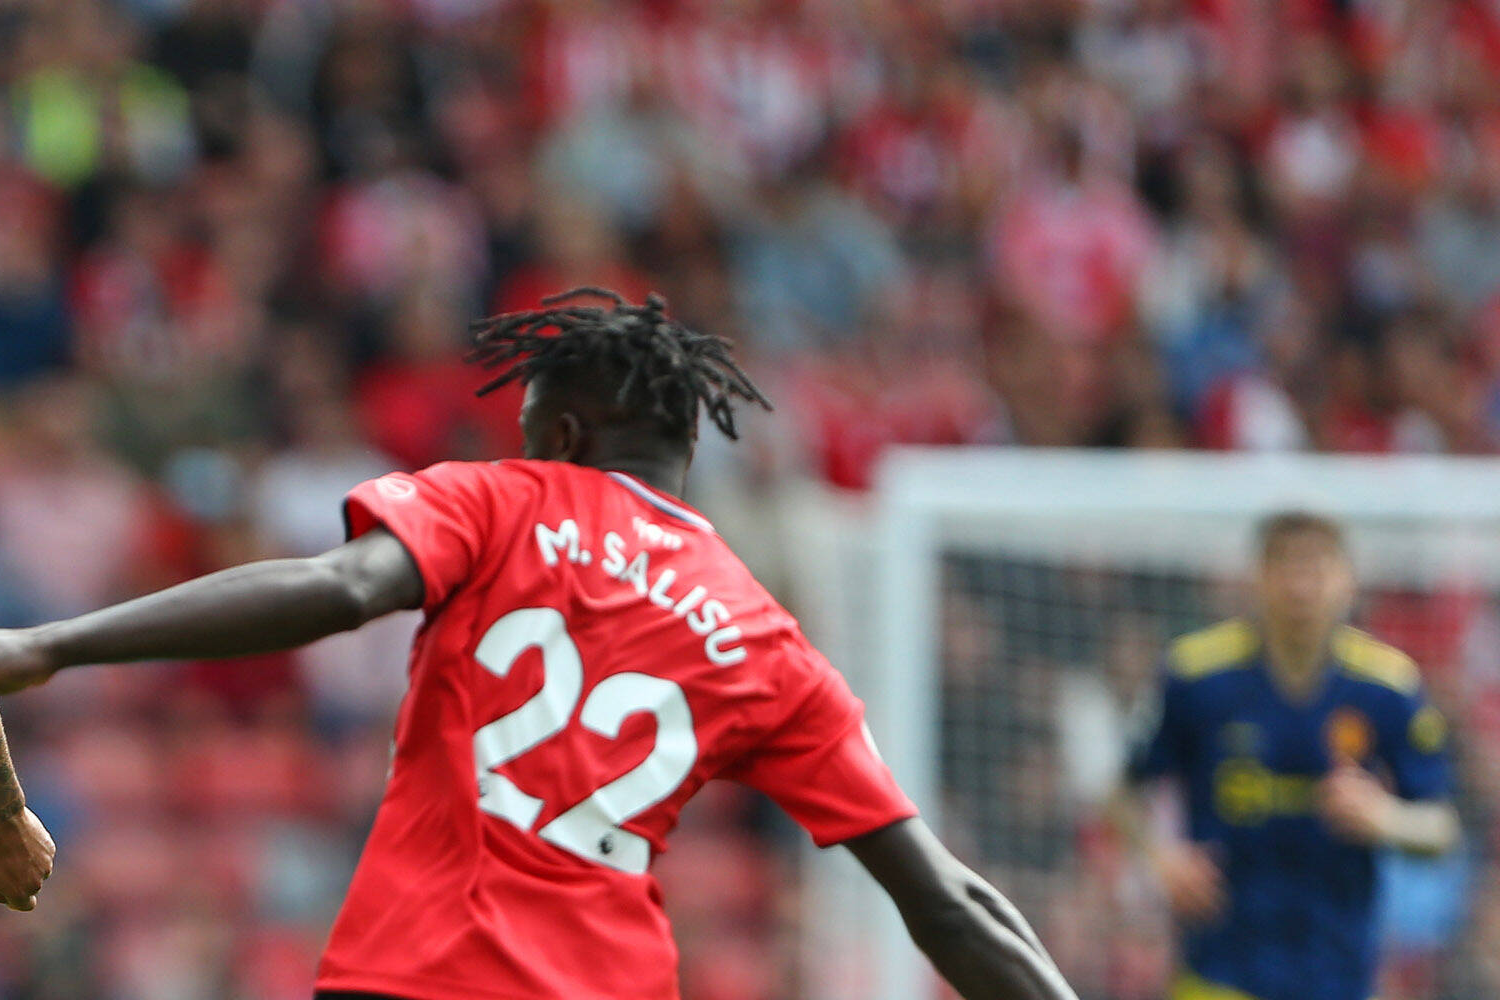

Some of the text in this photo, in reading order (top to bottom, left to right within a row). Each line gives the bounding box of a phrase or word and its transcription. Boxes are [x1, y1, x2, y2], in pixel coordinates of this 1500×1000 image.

[535, 519, 748, 666] M. SALISU
[474, 607, 698, 875] 22
